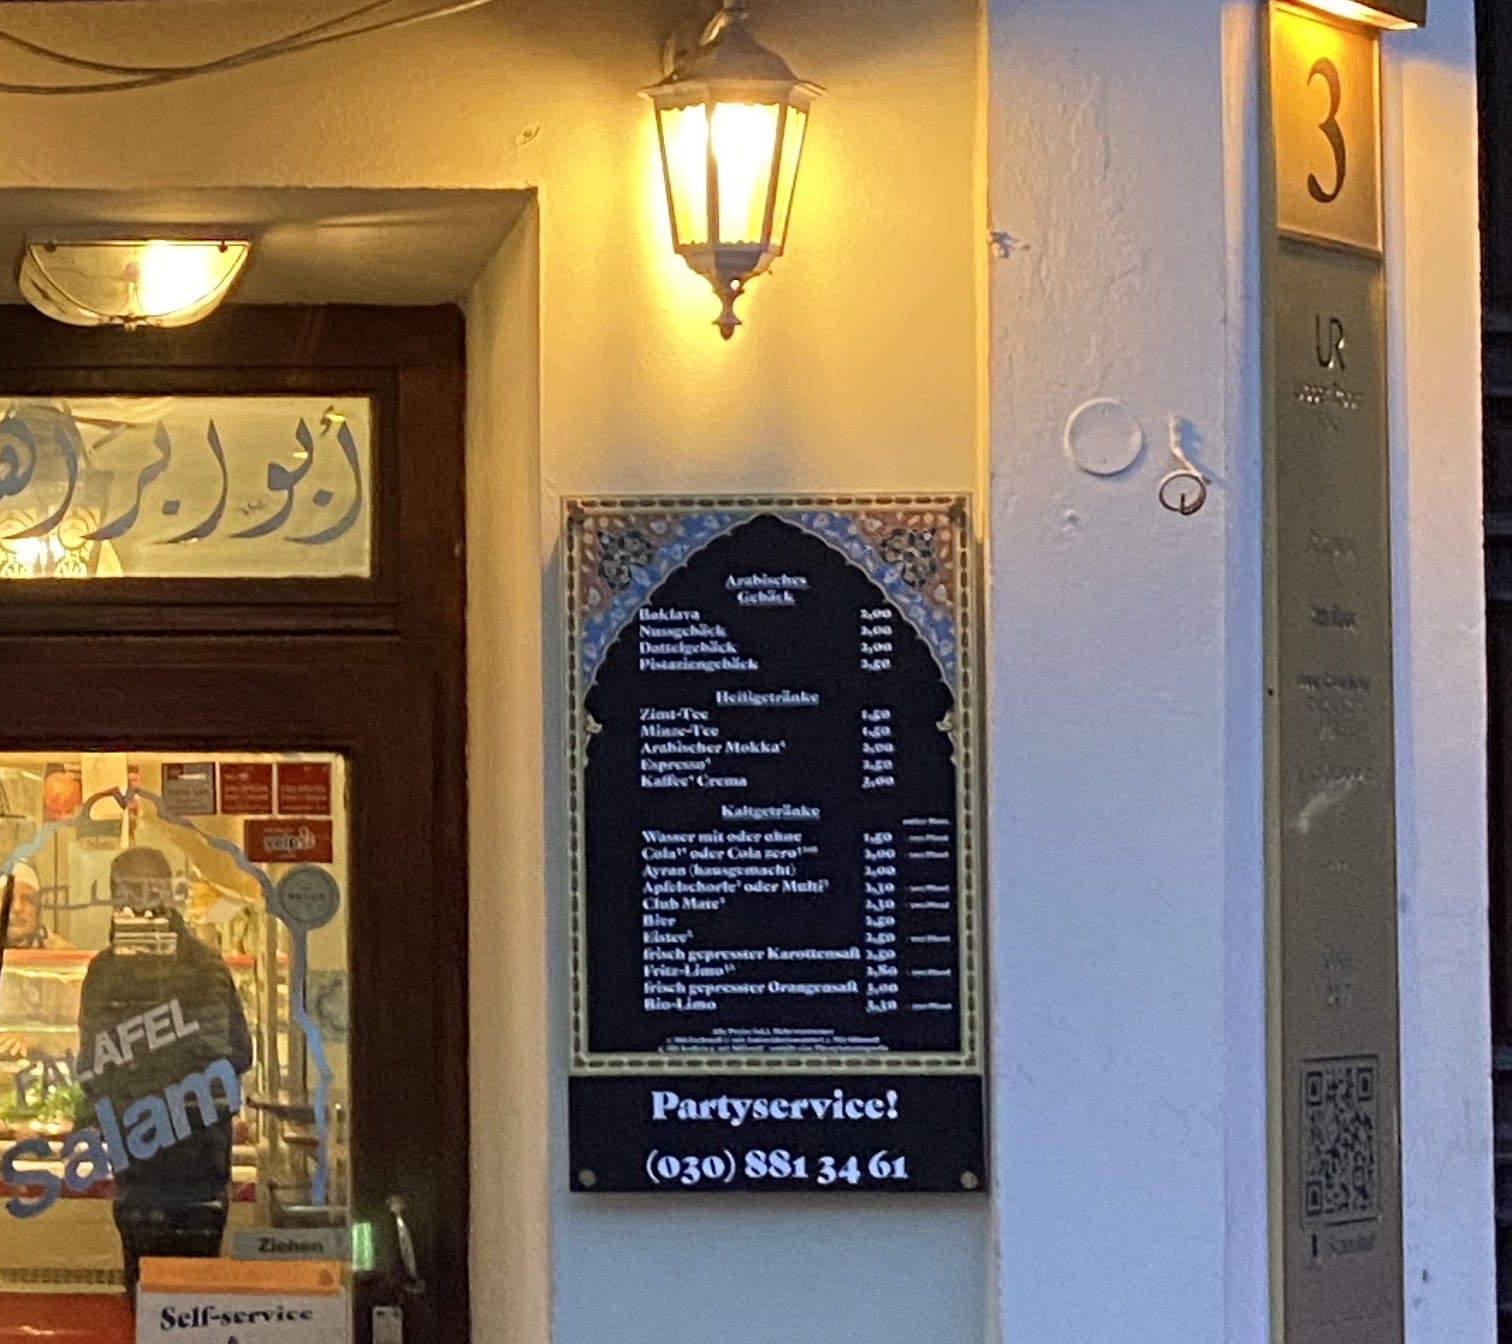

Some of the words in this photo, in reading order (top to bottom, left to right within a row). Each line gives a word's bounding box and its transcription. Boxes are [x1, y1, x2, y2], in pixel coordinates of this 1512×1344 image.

[1306, 56, 1345, 203] 3
[726, 574, 806, 588] Arabisches
[737, 590, 795, 605] Gebäck
[639, 606, 700, 620] Baklava
[861, 609, 892, 620] 2,00
[640, 624, 726, 639] Nussgebäck
[861, 626, 892, 636] 2,00
[640, 641, 737, 655] Dattelgebäck
[861, 642, 892, 654] 2,00
[640, 657, 758, 671] Pistaziengebäck
[640, 708, 708, 720] Zimt-Tee
[862, 710, 891, 721] 1,50
[641, 724, 719, 737] Minze-Tee
[862, 726, 890, 738] 1,50
[641, 740, 722, 754] Arabischer
[863, 743, 894, 753] 2,00
[697, 774, 747, 787] Crema
[722, 804, 820, 820] Kaltgetränke
[642, 831, 695, 842] Wasser
[698, 830, 724, 843] mit
[726, 830, 762, 842] oder
[764, 830, 802, 842] ohne
[864, 832, 892, 844] 1,50
[690, 847, 725, 859] oder
[727, 847, 762, 859] Cola
[865, 849, 895, 860] 2,00
[643, 864, 686, 879] Ayran
[690, 864, 796, 878] (hausgemacht)
[865, 866, 896, 877] 2,00
[744, 880, 779, 892] oder
[643, 897, 679, 910] Club
[643, 914, 676, 926] Bier
[644, 947, 685, 960] frisch
[687, 950, 765, 965] gepresster
[767, 947, 860, 959] Karottensaft
[644, 981, 686, 994] frisch
[688, 984, 765, 998] gepresster
[768, 980, 858, 995] Orangensaft
[644, 997, 716, 1010] Bio-Limo
[15, 998, 200, 1107] FALAFEL
[652, 1089, 898, 1126] Partyservice!
[0, 1058, 242, 1220] Salam
[647, 1150, 735, 1184] (030)
[745, 1149, 808, 1178] 881
[817, 1156, 860, 1184] 34
[869, 1150, 908, 1178] 61
[160, 1305, 314, 1330] Self-service
